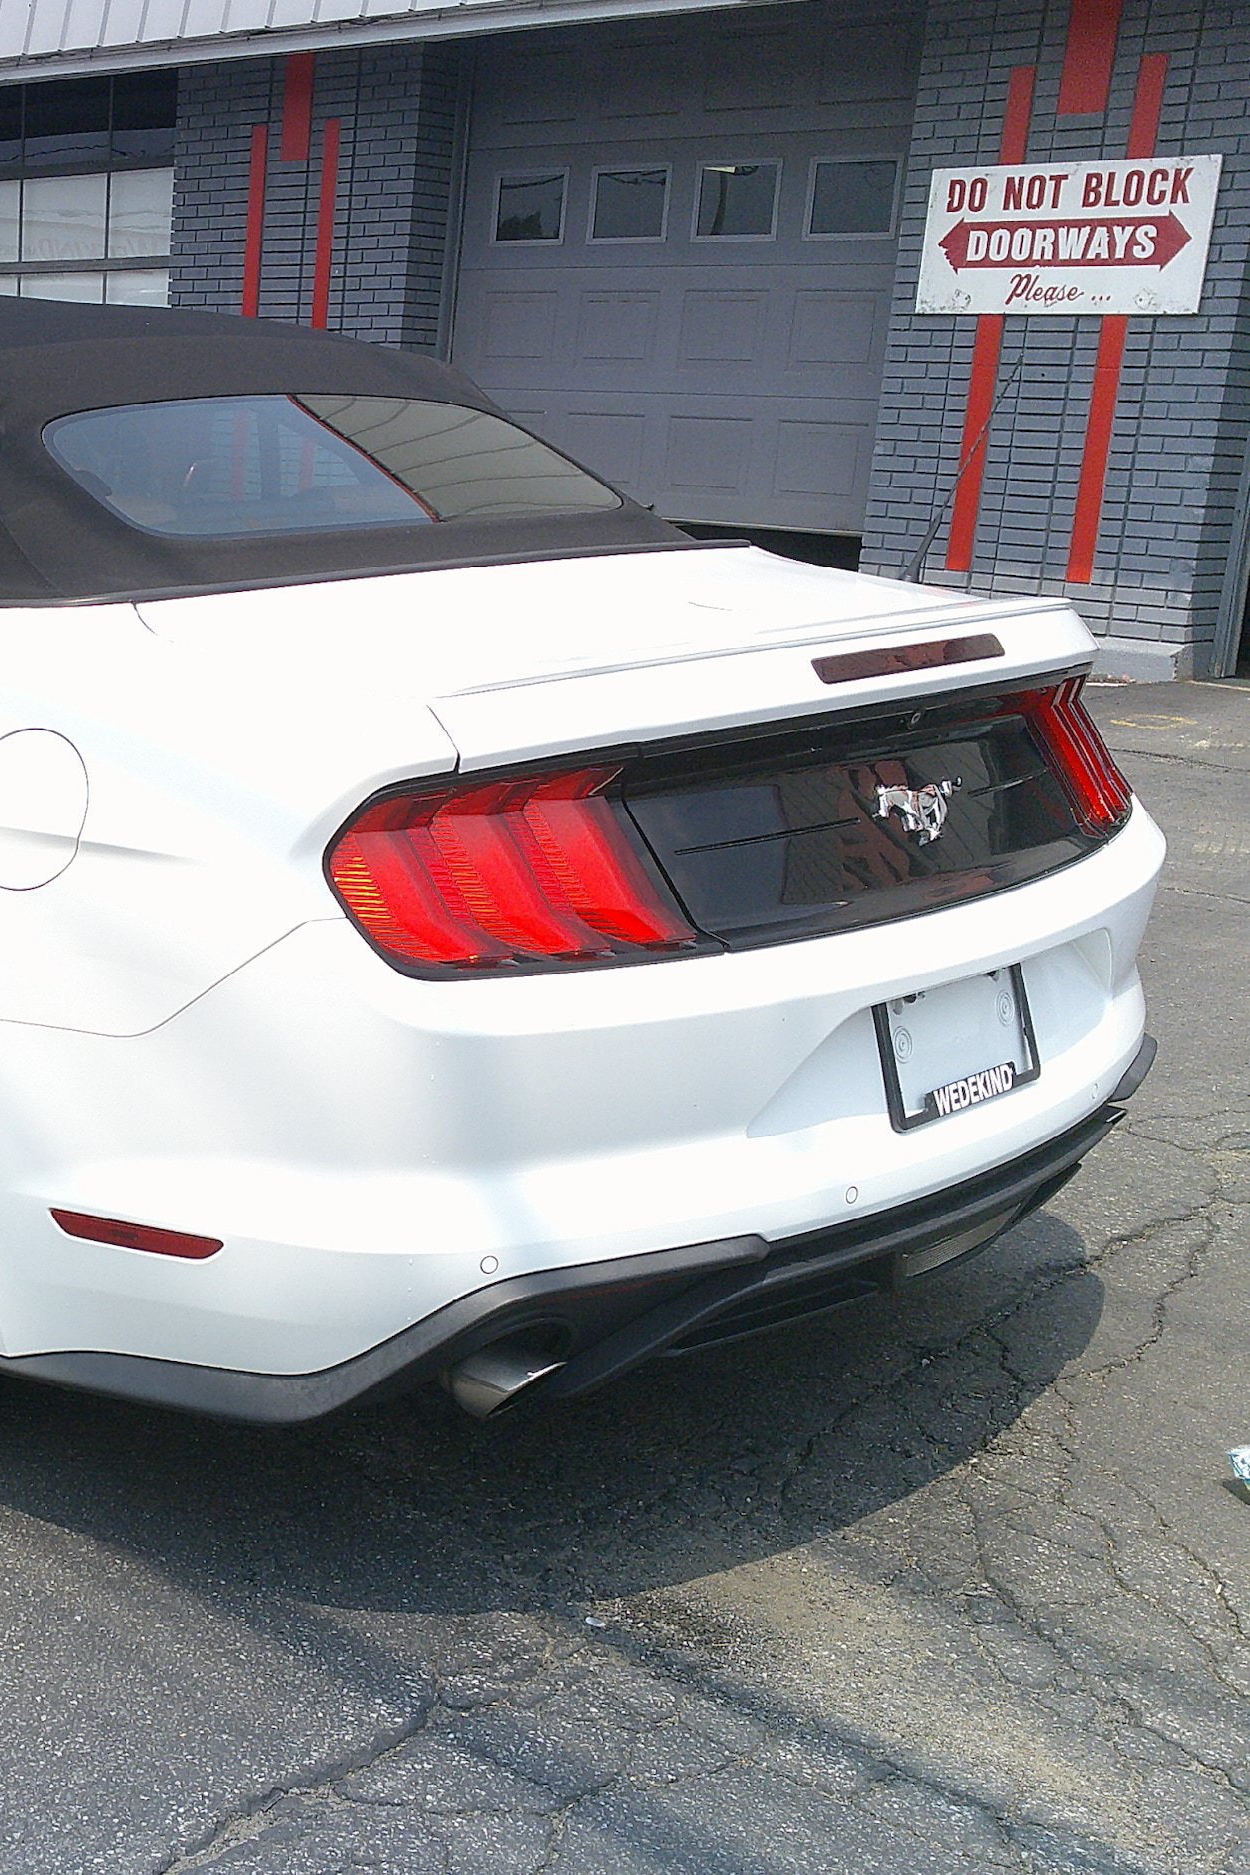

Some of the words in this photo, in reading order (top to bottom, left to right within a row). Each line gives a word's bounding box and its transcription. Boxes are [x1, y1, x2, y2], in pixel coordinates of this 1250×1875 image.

[946, 177, 989, 213] DO
[1002, 174, 1069, 211] NOT
[1081, 167, 1195, 208] BLOCK
[965, 224, 1159, 263] DOORWAYS
[1005, 273, 1085, 305] Please
[933, 1064, 1013, 1116] WEDEKIND
